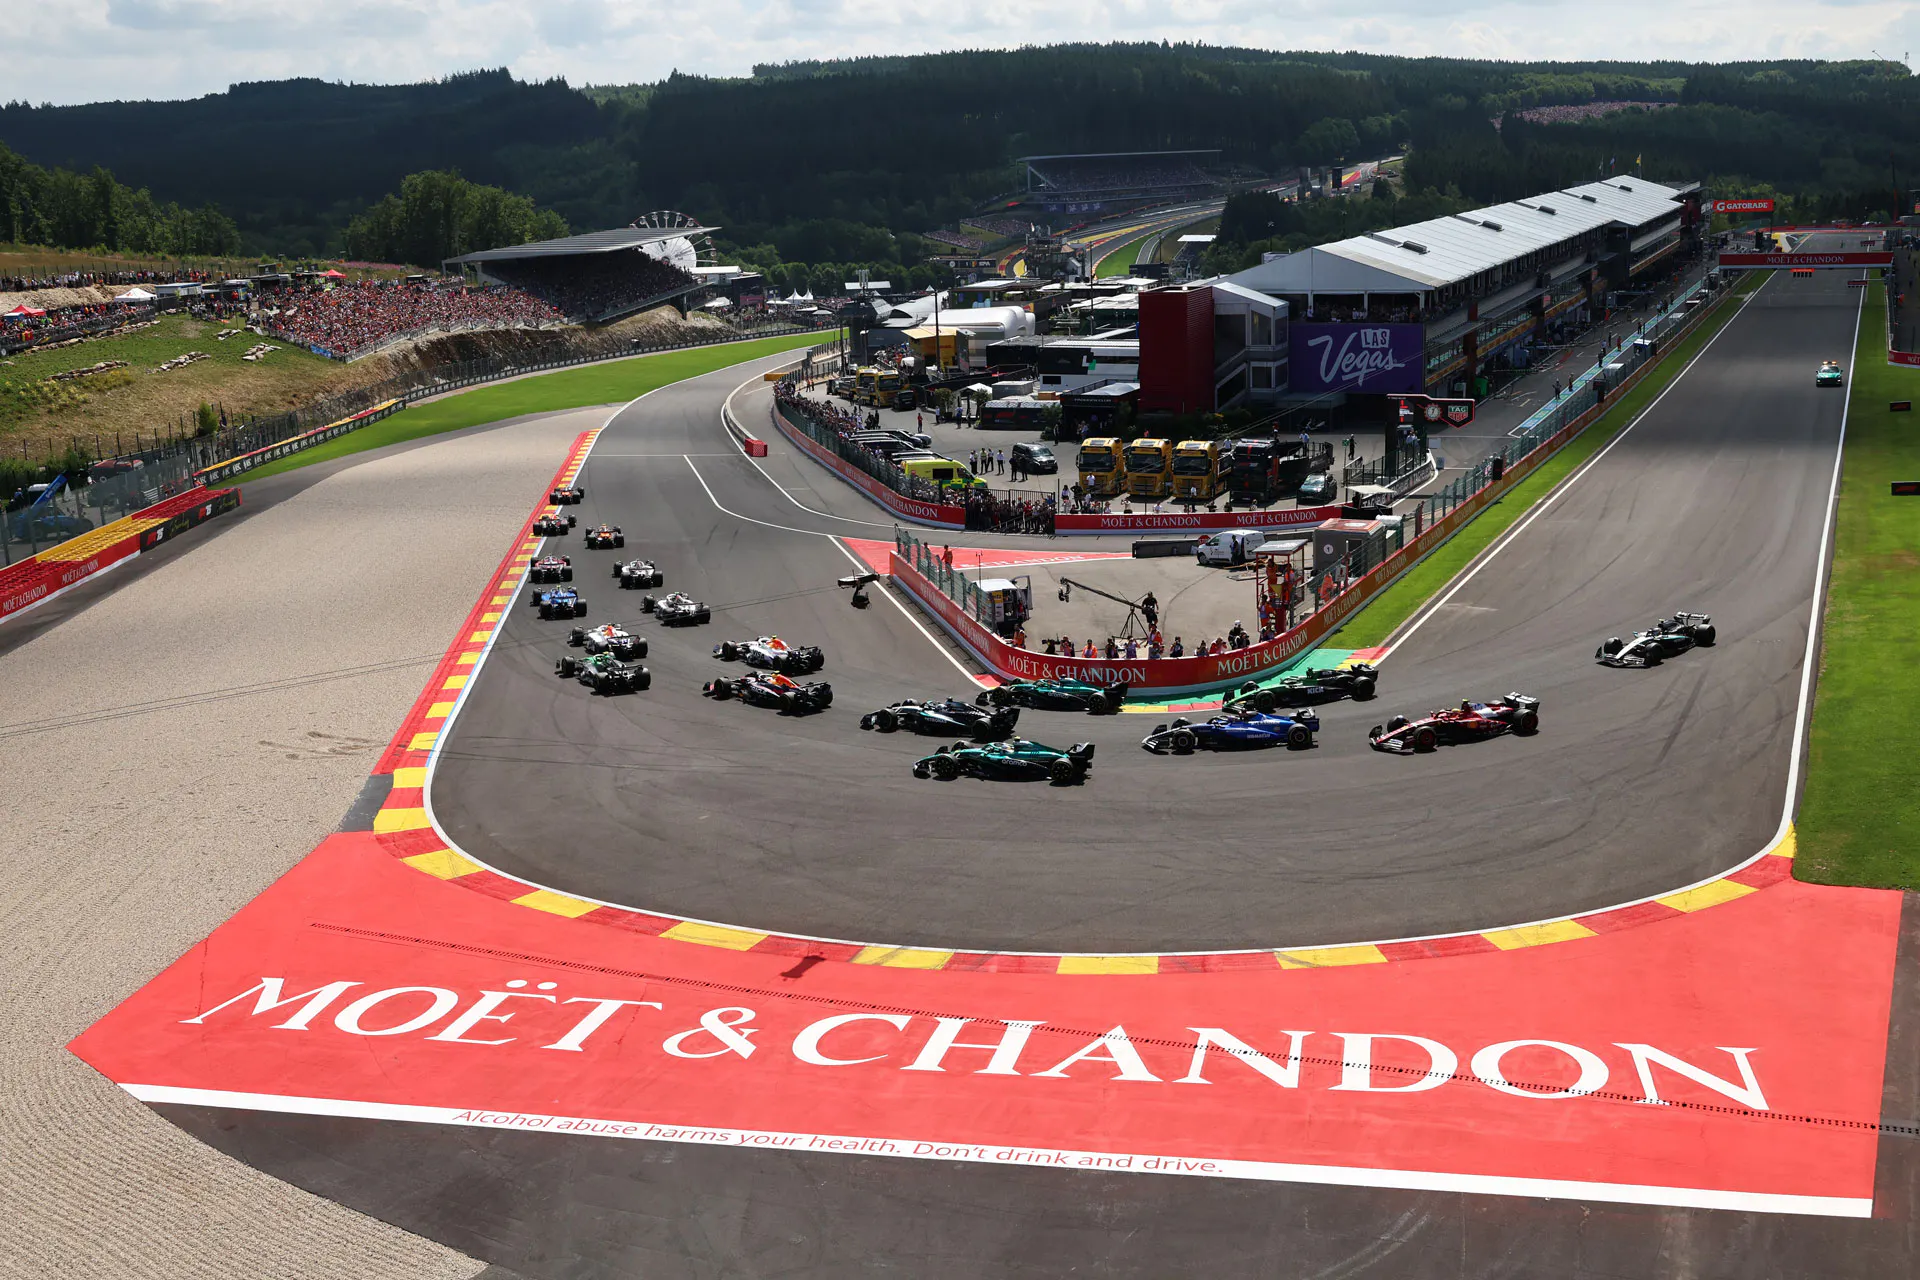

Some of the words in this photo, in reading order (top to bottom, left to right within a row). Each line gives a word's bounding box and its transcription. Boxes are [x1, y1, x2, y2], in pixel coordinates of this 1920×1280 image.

[1766, 254, 1791, 264] MOËT
[1363, 330, 1388, 347] LAS
[1308, 332, 1405, 387] Vegas
[896, 499, 938, 518] CHANDON
[1100, 514, 1133, 527] MOËT
[1135, 517, 1143, 527] &
[1145, 516, 1201, 527] CHANDON
[1236, 512, 1264, 525] MOËT
[1267, 513, 1274, 523] &
[1274, 510, 1317, 523] CHANDON
[2, 595, 20, 614] MOËT
[22, 583, 47, 604] CHANDON
[1323, 605, 1337, 627] MOËT
[1340, 587, 1362, 614] CHANDON
[1217, 651, 1260, 677] MOËT
[1263, 649, 1272, 665] &
[1272, 627, 1308, 661] CHANDON
[1008, 655, 1039, 676] MOËT
[1042, 663, 1053, 679] &
[1055, 665, 1146, 684] CHANDON
[1307, 686, 1324, 694] KICK
[1001, 758, 1027, 767] aramco
[178, 977, 664, 1053] MOËT
[662, 1006, 759, 1060] &
[793, 1013, 1770, 1112] CHANDON
[452, 1109, 554, 1129] Alcohol
[556, 1117, 638, 1136] abuse
[644, 1124, 731, 1143] harms
[733, 1131, 803, 1147] your
[808, 1135, 901, 1153] health.
[912, 1141, 986, 1159] Don't
[995, 1147, 1069, 1165] drink
[1077, 1151, 1134, 1168] and
[1142, 1155, 1223, 1173] drive.
